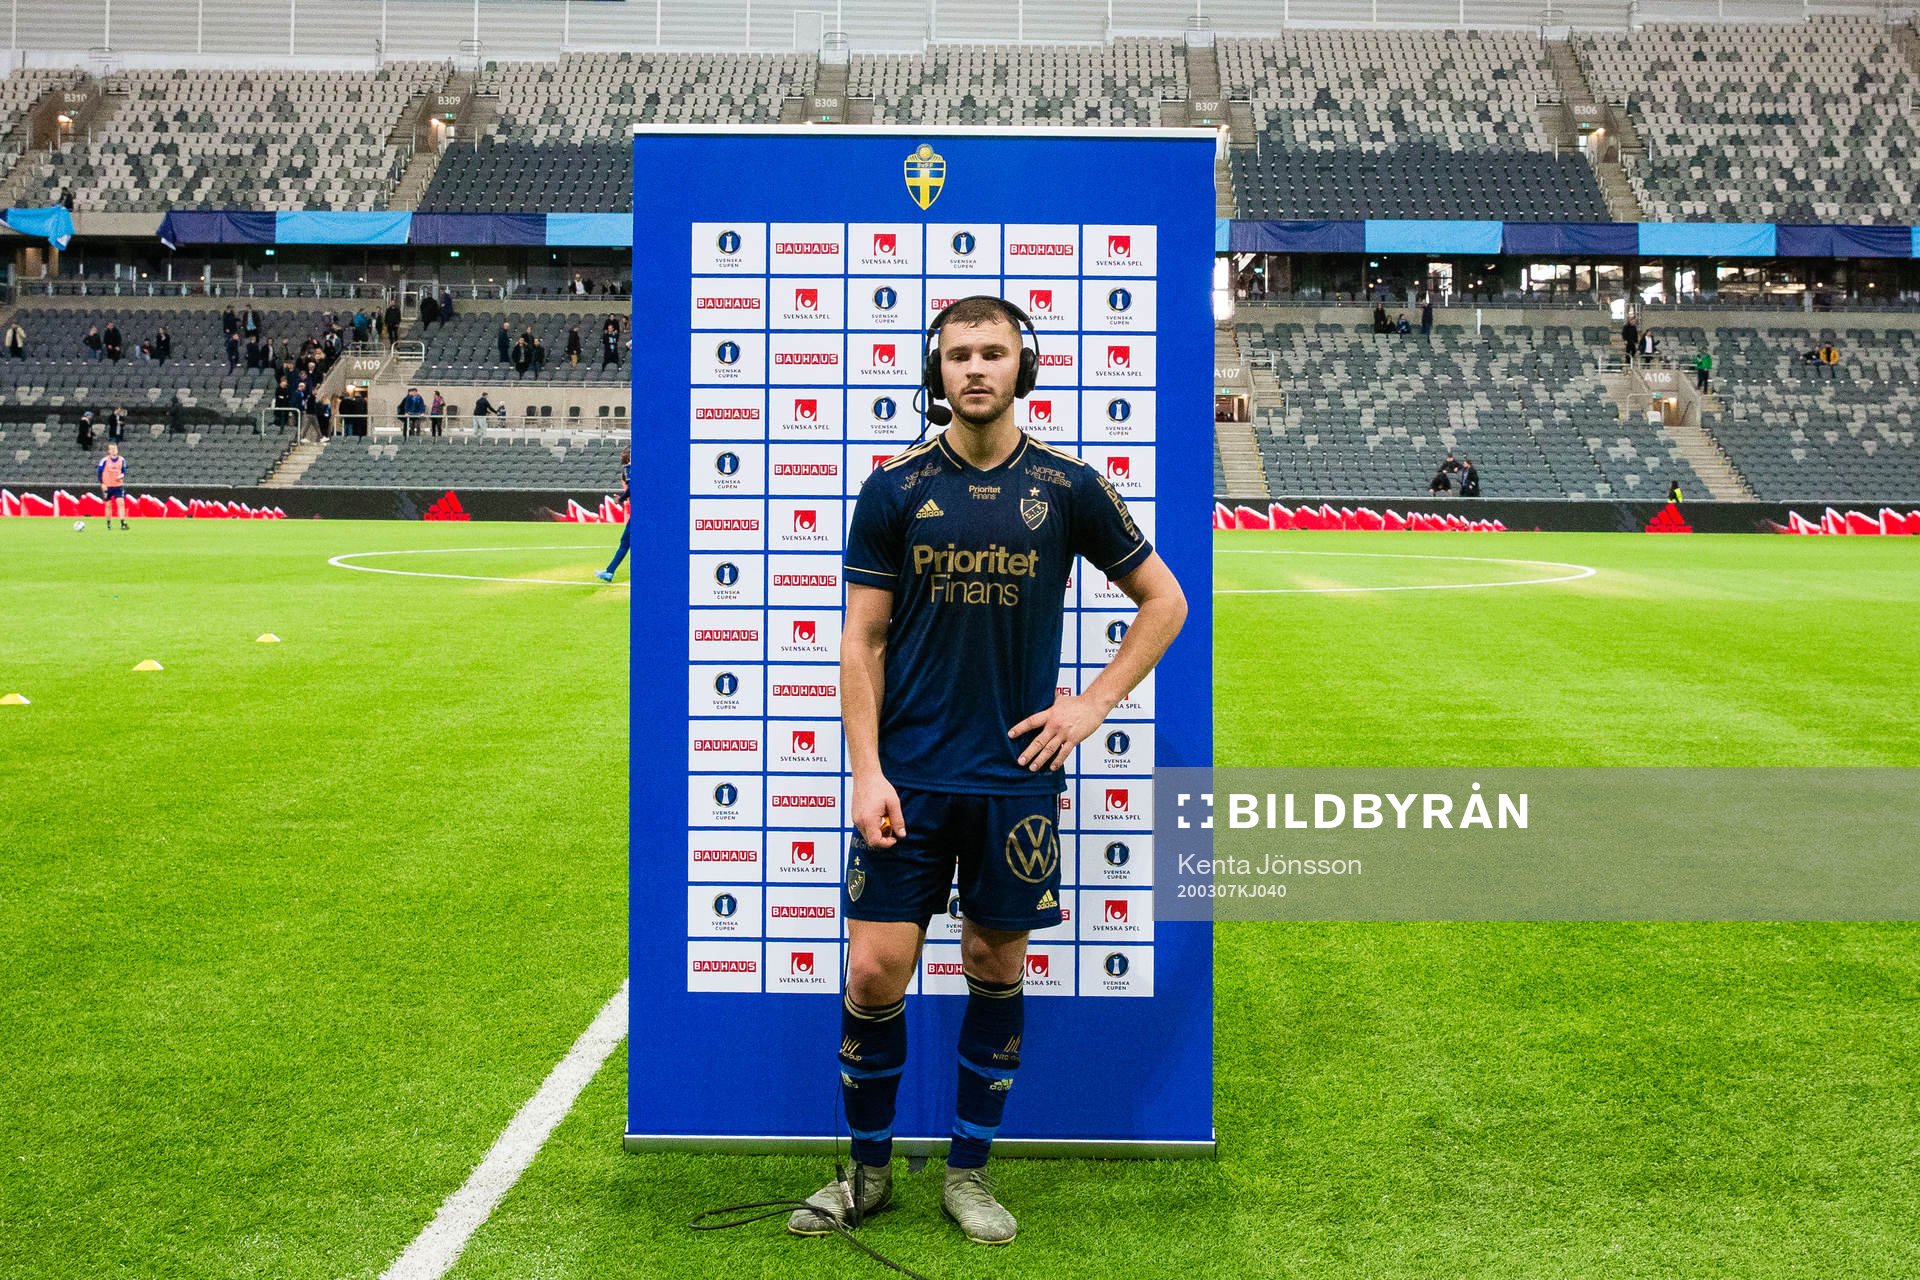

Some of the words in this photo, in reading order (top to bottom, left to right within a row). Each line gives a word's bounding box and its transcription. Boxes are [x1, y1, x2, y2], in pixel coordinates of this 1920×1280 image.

[438, 96, 460, 105] B309
[815, 98, 838, 108] B308
[1195, 102, 1218, 111] B307
[1574, 105, 1598, 115] B306
[776, 243, 838, 254] BAUHAUS
[1010, 244, 1072, 255] BAUHAUS
[697, 298, 760, 309] BAUHAUS
[353, 360, 381, 370] A109
[775, 354, 838, 365] BAUHAUS
[1039, 355, 1072, 366] HAUS
[1215, 368, 1240, 378] A107
[1644, 372, 1671, 383] A106
[697, 408, 759, 420] BAUHAUS
[775, 464, 837, 475] BAUHAUS
[1033, 465, 1065, 478] NORDIC
[1025, 468, 1072, 488] WELLNESS
[969, 485, 1001, 493] Prioritet
[916, 509, 944, 519] adidas
[696, 519, 758, 530] BAUHAUS
[913, 543, 1039, 578] Prioritet
[774, 575, 836, 586] BAUHAUS
[930, 574, 1019, 606] Finans
[695, 630, 758, 641] BAUHAUS
[773, 685, 836, 697] BAUHAUS
[695, 740, 757, 751] BAUHAUS
[772, 796, 835, 807] BAUHAUS
[694, 851, 756, 862] BAUHAUS
[1037, 901, 1058, 910] adidas
[772, 907, 834, 918] BAUHAUS
[693, 961, 756, 972] BAUHAUS
[928, 963, 963, 975] BAUH
